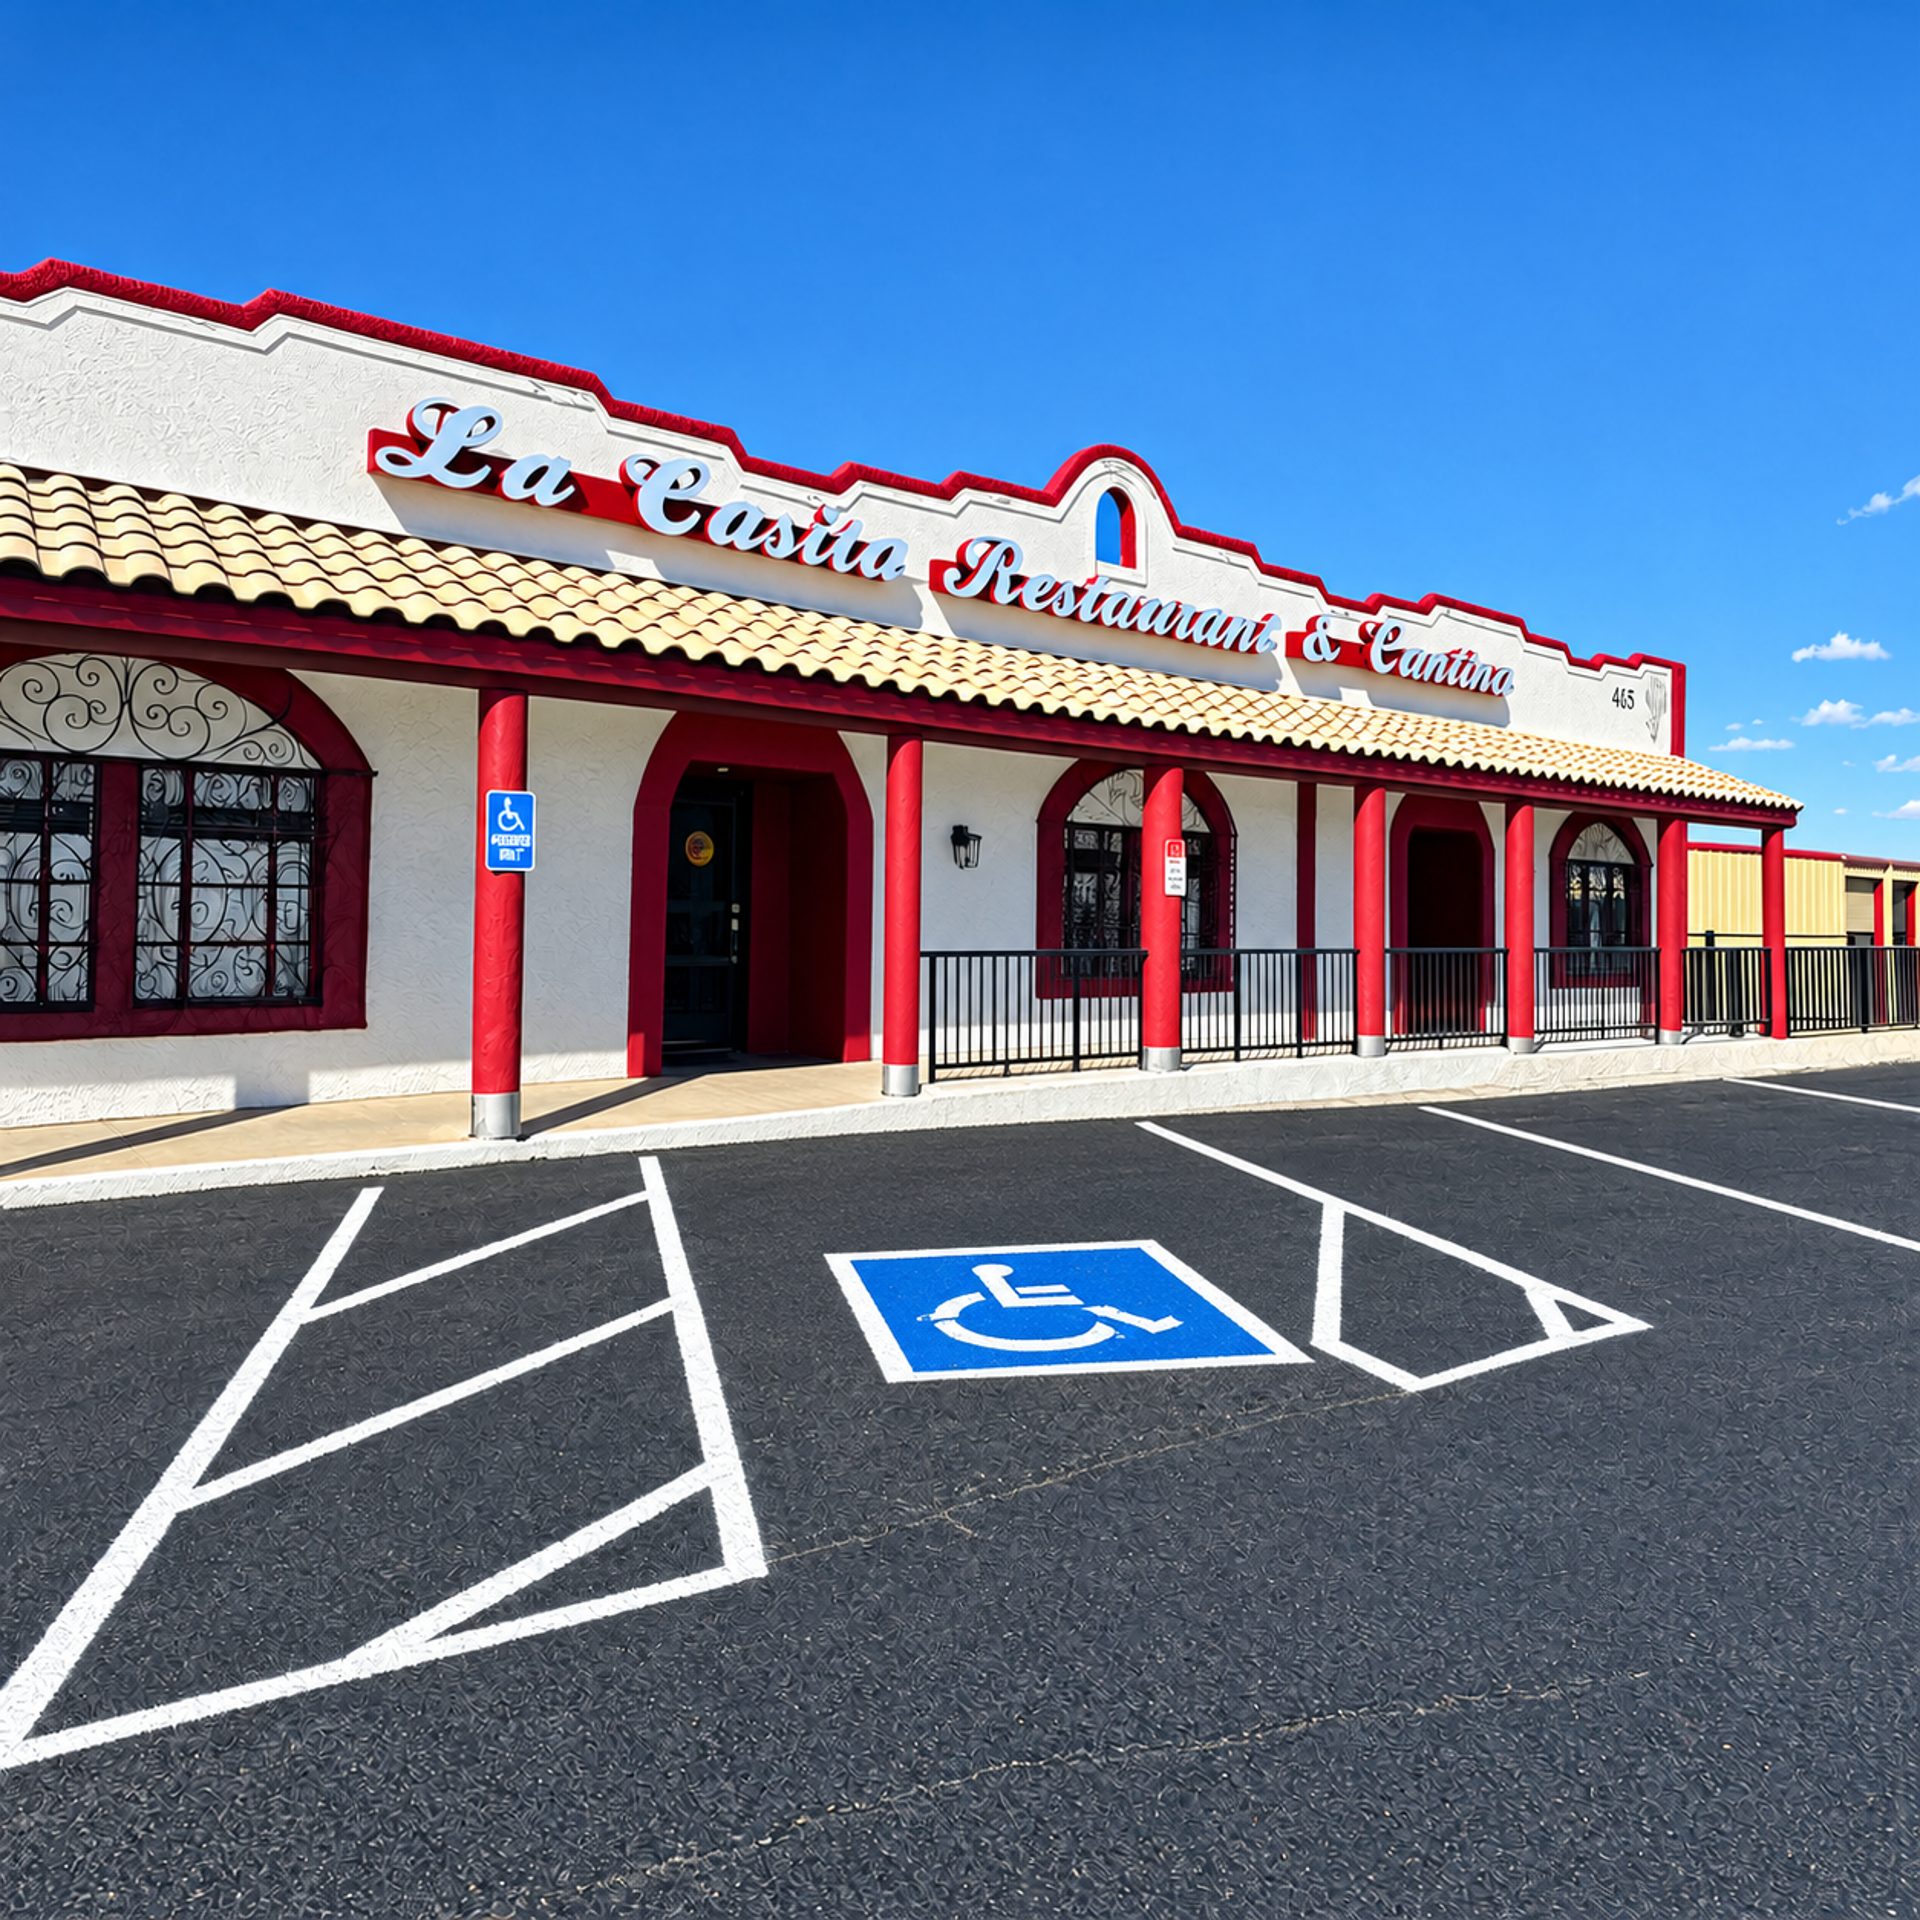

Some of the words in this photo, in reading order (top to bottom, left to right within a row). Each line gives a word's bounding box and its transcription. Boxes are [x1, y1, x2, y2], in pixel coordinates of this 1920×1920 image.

[374, 396, 576, 507] La
[620, 452, 910, 582] Casita
[942, 535, 1282, 654] Restaurant
[1302, 614, 1341, 663] &
[1361, 617, 1515, 696] Cantina
[1611, 686, 1635, 710] 465
